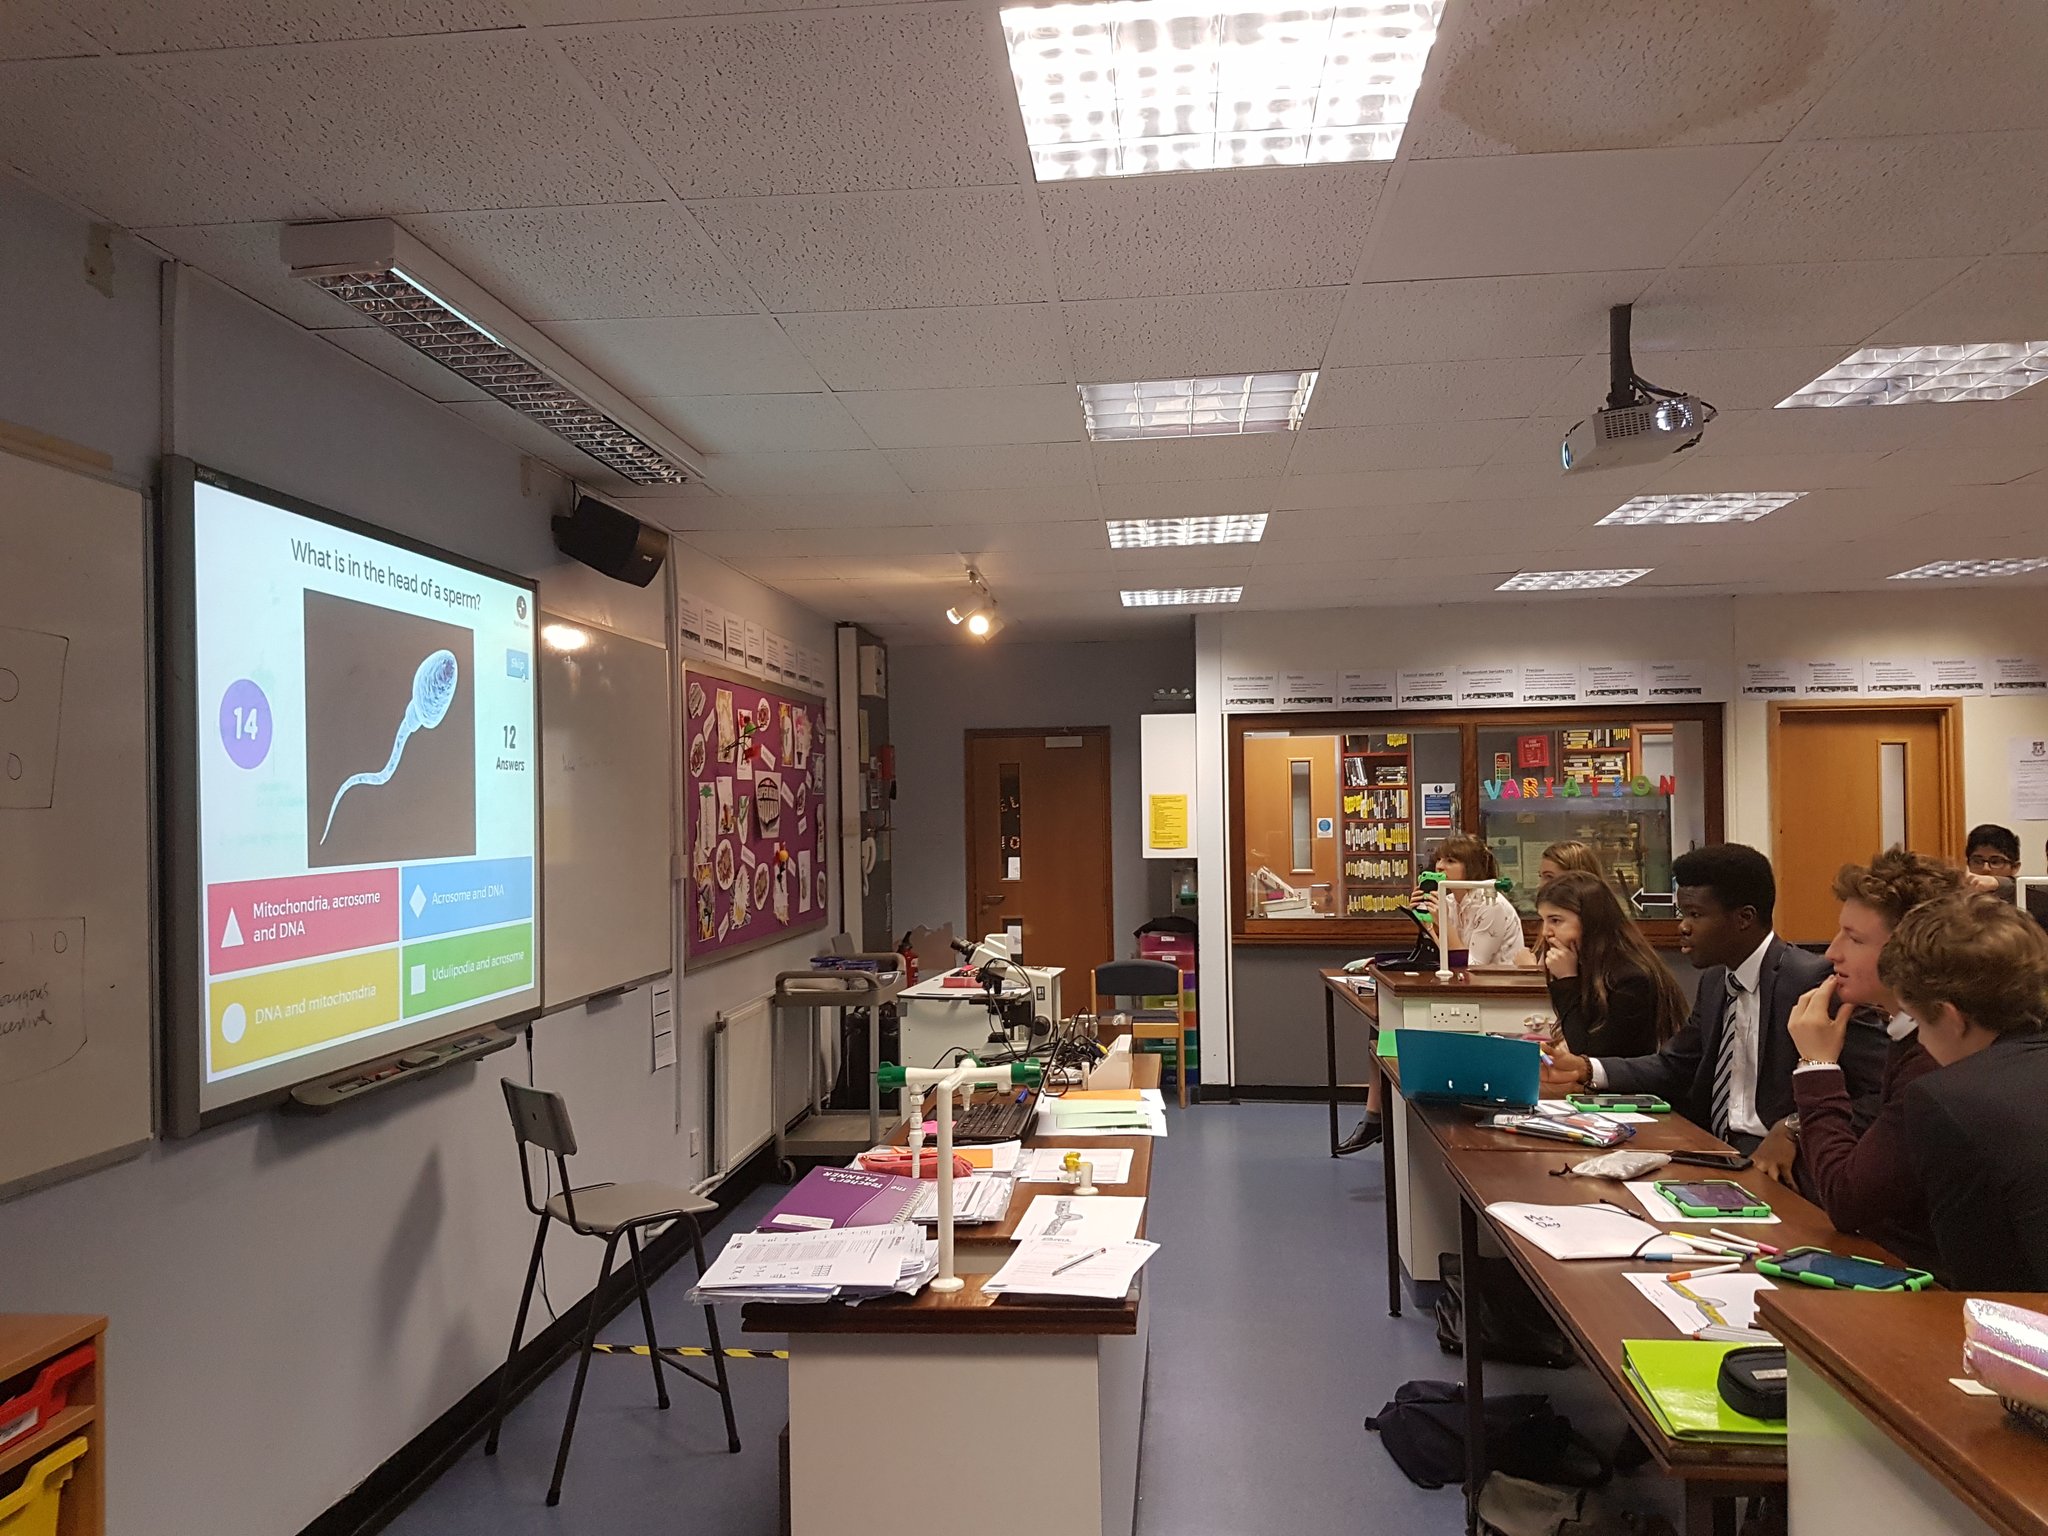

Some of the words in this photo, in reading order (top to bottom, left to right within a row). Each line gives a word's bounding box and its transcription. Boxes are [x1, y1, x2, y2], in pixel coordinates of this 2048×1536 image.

[290, 537, 332, 570] What
[334, 549, 345, 573] is
[348, 554, 361, 579] in
[364, 560, 385, 585] the
[388, 566, 418, 594] head
[421, 578, 433, 597] of
[435, 584, 441, 600] a
[443, 587, 481, 611] sperm?
[234, 707, 258, 740] 14
[503, 725, 516, 749] 12
[496, 757, 525, 771] Answers
[1483, 774, 1676, 800] VARIATION
[253, 895, 330, 919] Mitochondria,
[332, 892, 380, 908] acrosome
[431, 891, 471, 906] Acrosome
[472, 885, 487, 900] and
[488, 884, 505, 897] DNA
[253, 923, 276, 942] and
[279, 920, 306, 938] DNA
[476, 956, 490, 971] and
[491, 951, 525, 967] acrosome
[255, 1004, 282, 1025] DNA
[285, 998, 306, 1017] and
[308, 984, 377, 1010] mitochondria
[822, 1171, 879, 1182] PLANNER
